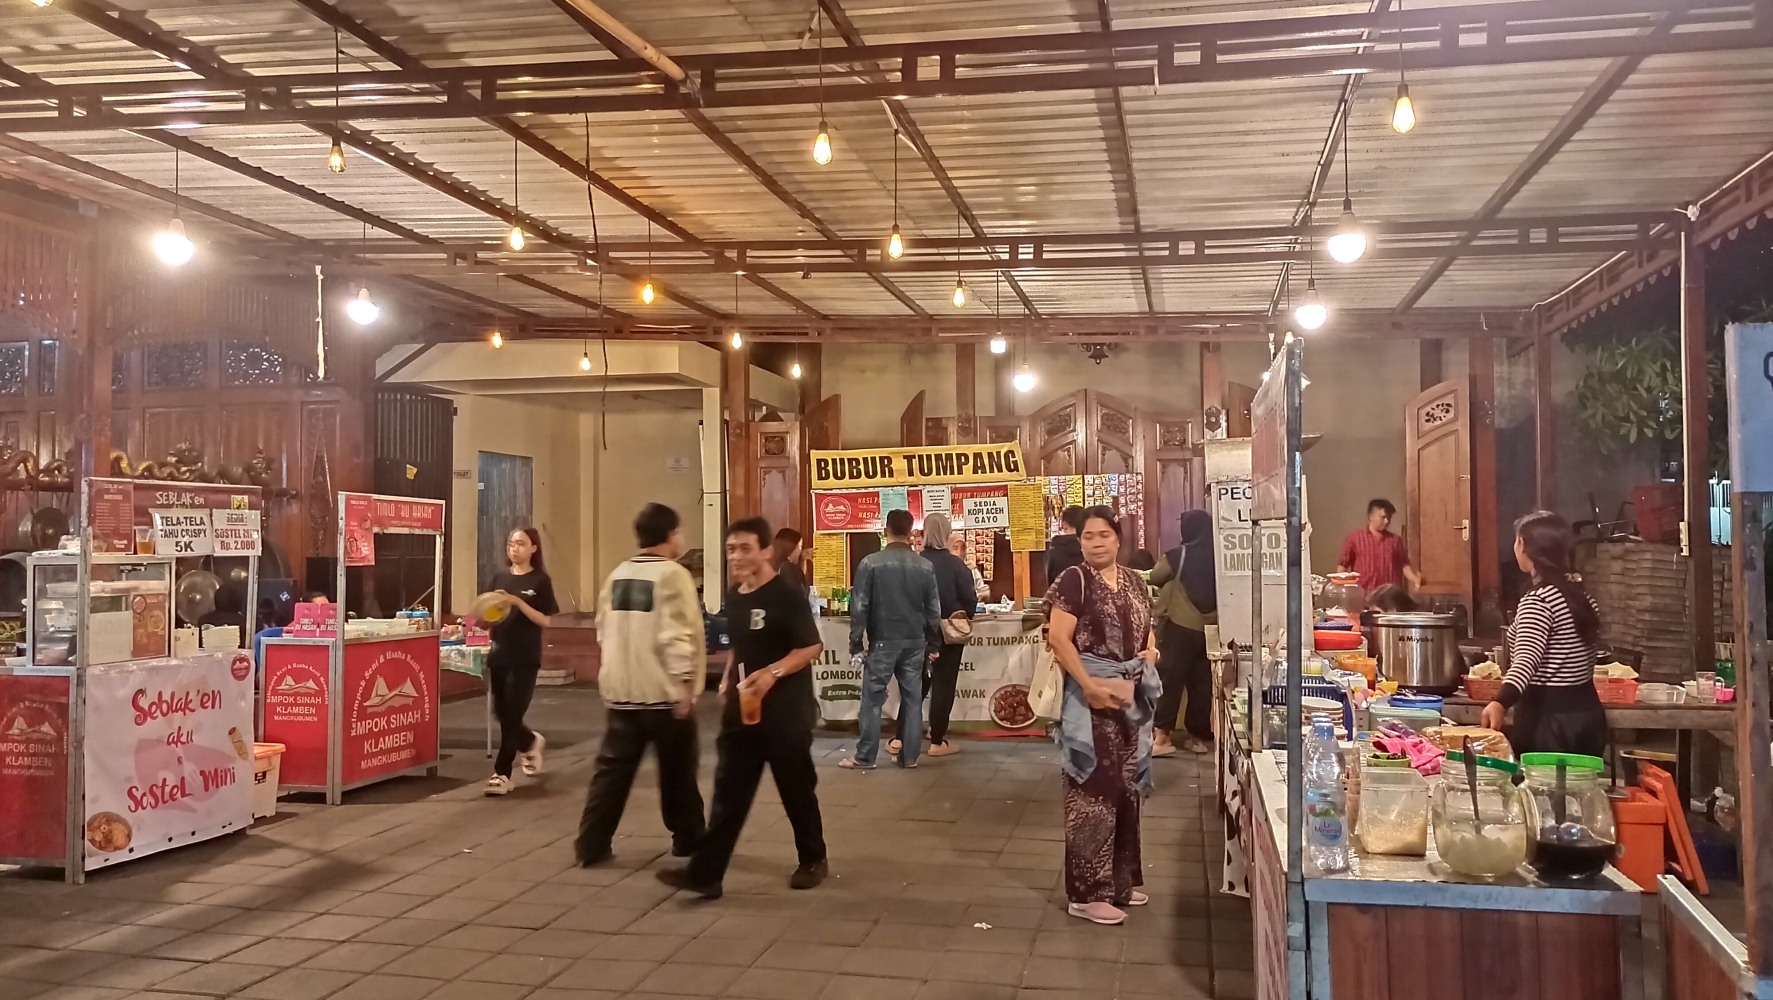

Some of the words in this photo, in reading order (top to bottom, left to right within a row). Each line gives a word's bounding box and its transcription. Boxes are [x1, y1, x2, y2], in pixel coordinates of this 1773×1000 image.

[815, 455, 894, 481] BUBUR
[902, 449, 1020, 478] TUMPANG
[973, 490, 1004, 498] TUMPANG
[973, 500, 997, 508] SEDIA
[985, 507, 1004, 515] ACEH
[160, 516, 206, 526] TELA-TELA
[974, 515, 998, 524] GAYO
[180, 528, 207, 539] CRISPY
[175, 540, 195, 553] 5K
[220, 541, 233, 552] Rp.
[234, 540, 256, 551] 2.000
[1223, 551, 1282, 572] LAMOGAN
[749, 608, 767, 630] B
[986, 635, 1040, 647] TUMPANG
[815, 670, 862, 681] LOMBOK
[271, 695, 295, 704] MPOK
[296, 696, 322, 704] SINAH
[131, 686, 222, 727] Seblak'en
[276, 705, 316, 714] KLAMBEN
[356, 715, 388, 736] MPOK
[390, 709, 421, 728] SINAH
[166, 725, 194, 748] aku
[364, 730, 414, 755] KLAMBEN
[5, 756, 52, 767] KLAMBEN
